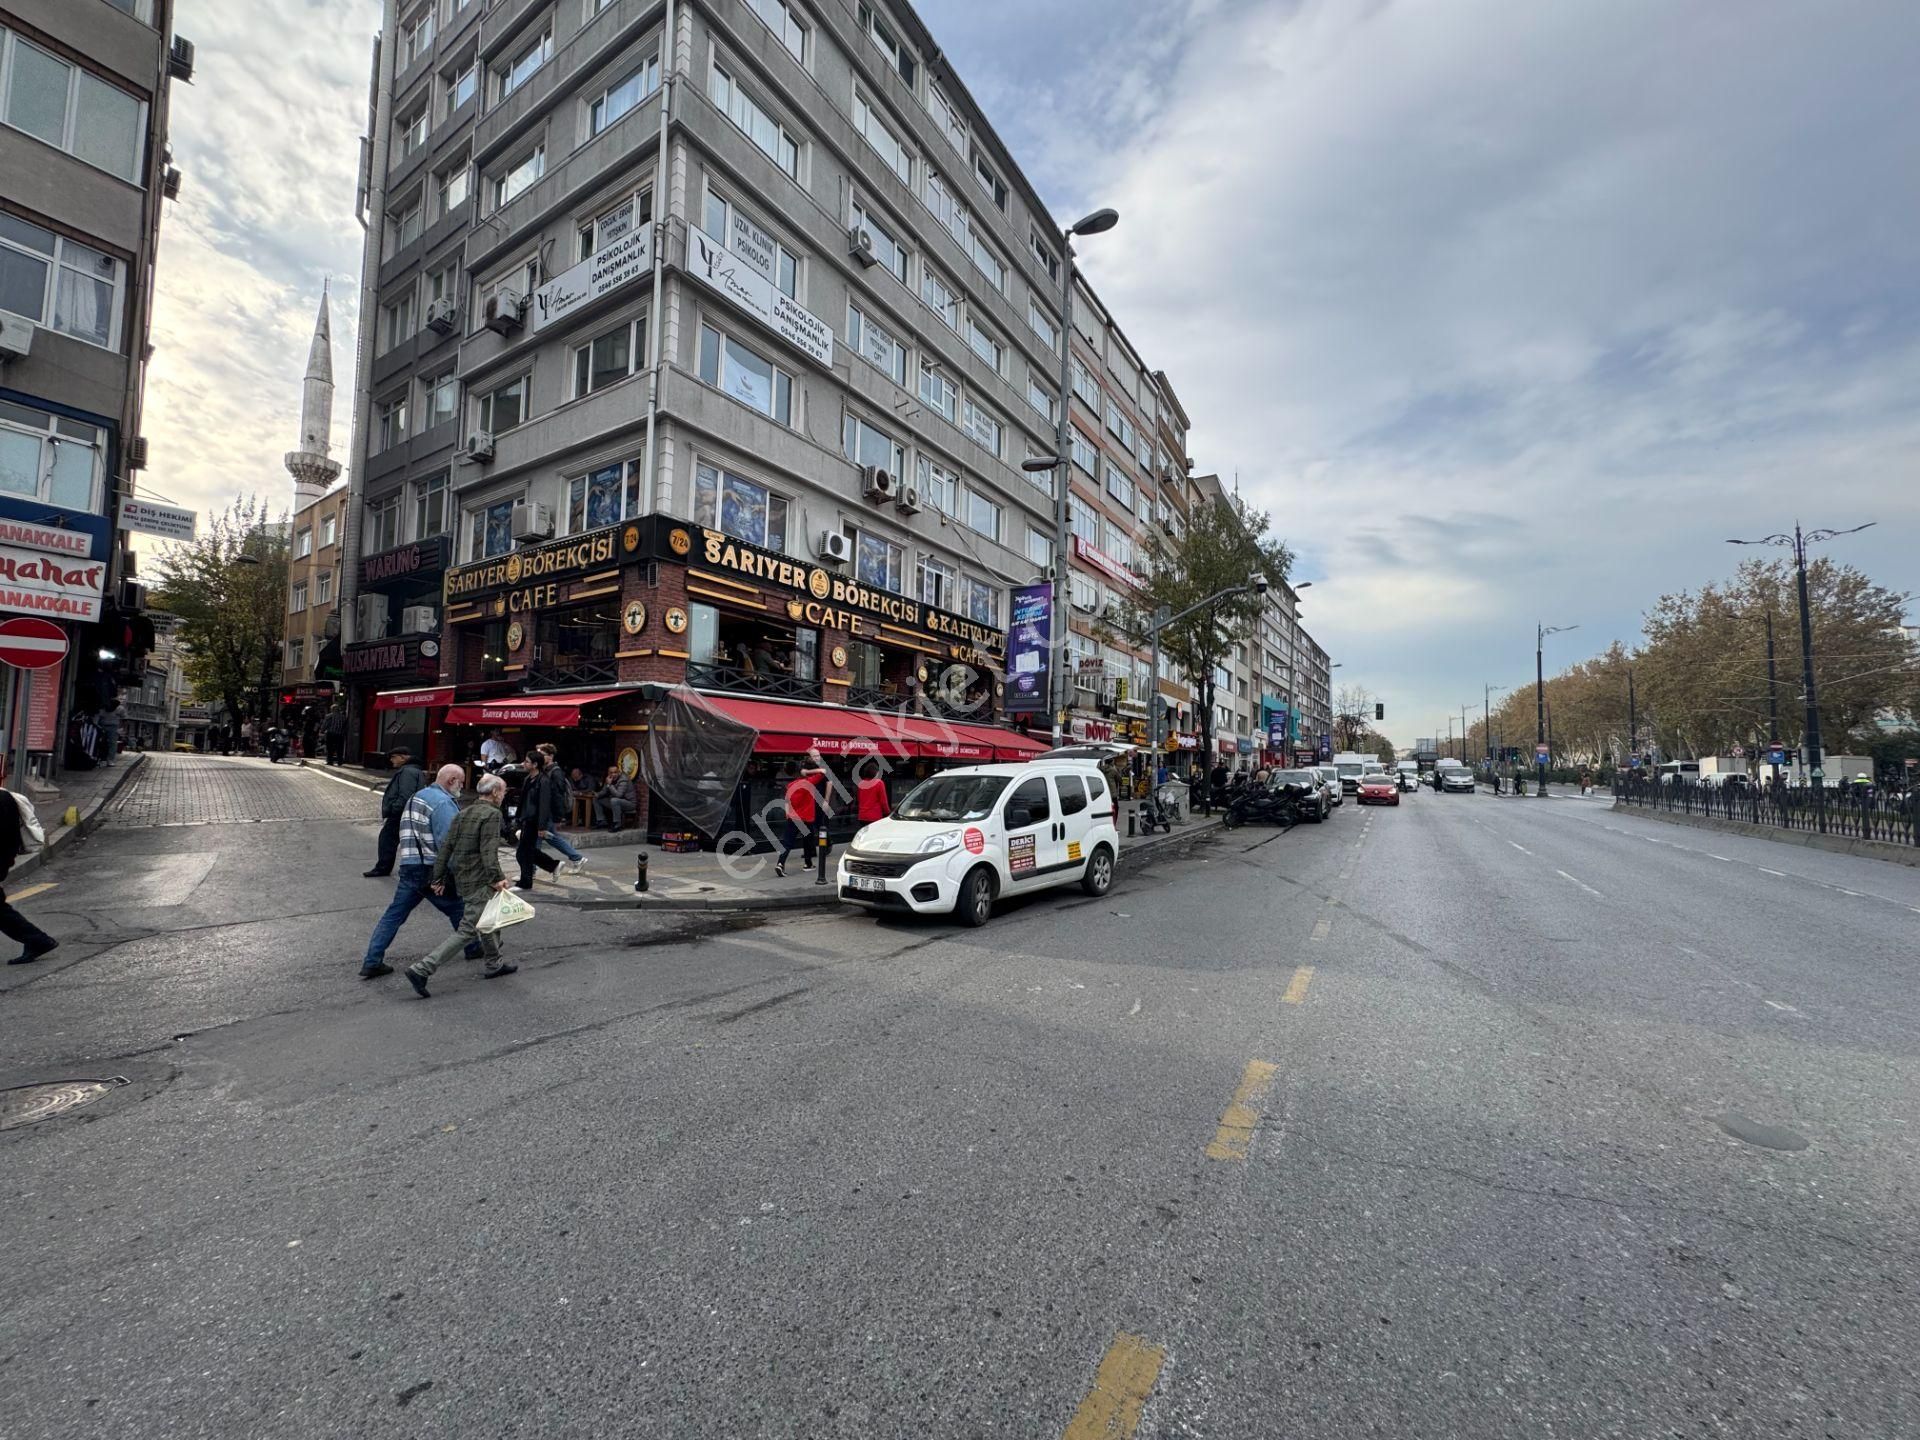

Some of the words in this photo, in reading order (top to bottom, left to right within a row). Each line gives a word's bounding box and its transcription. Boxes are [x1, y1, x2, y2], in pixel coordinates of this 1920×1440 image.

[591, 244, 646, 284] DANIŞMANLIK
[597, 233, 641, 267] PSİKOLOJİK
[737, 236, 770, 271] PSİKOLOG
[774, 305, 829, 352] DANIŞMANLIK
[779, 296, 825, 336] PSİKOLOJİK
[140, 508, 156, 518] DİŞ
[159, 511, 192, 523] HEKİMİ
[672, 535, 688, 548] 7/24
[447, 565, 506, 596] SARIYER
[523, 533, 614, 578] BÖREKÇİSİ
[704, 538, 806, 590] SARIYER
[833, 579, 919, 624] BÖREKÇİSİ
[509, 583, 557, 613] CAFE
[805, 602, 863, 635] CAFE
[959, 644, 983, 666] CAFE
[812, 737, 839, 749] SARIYER
